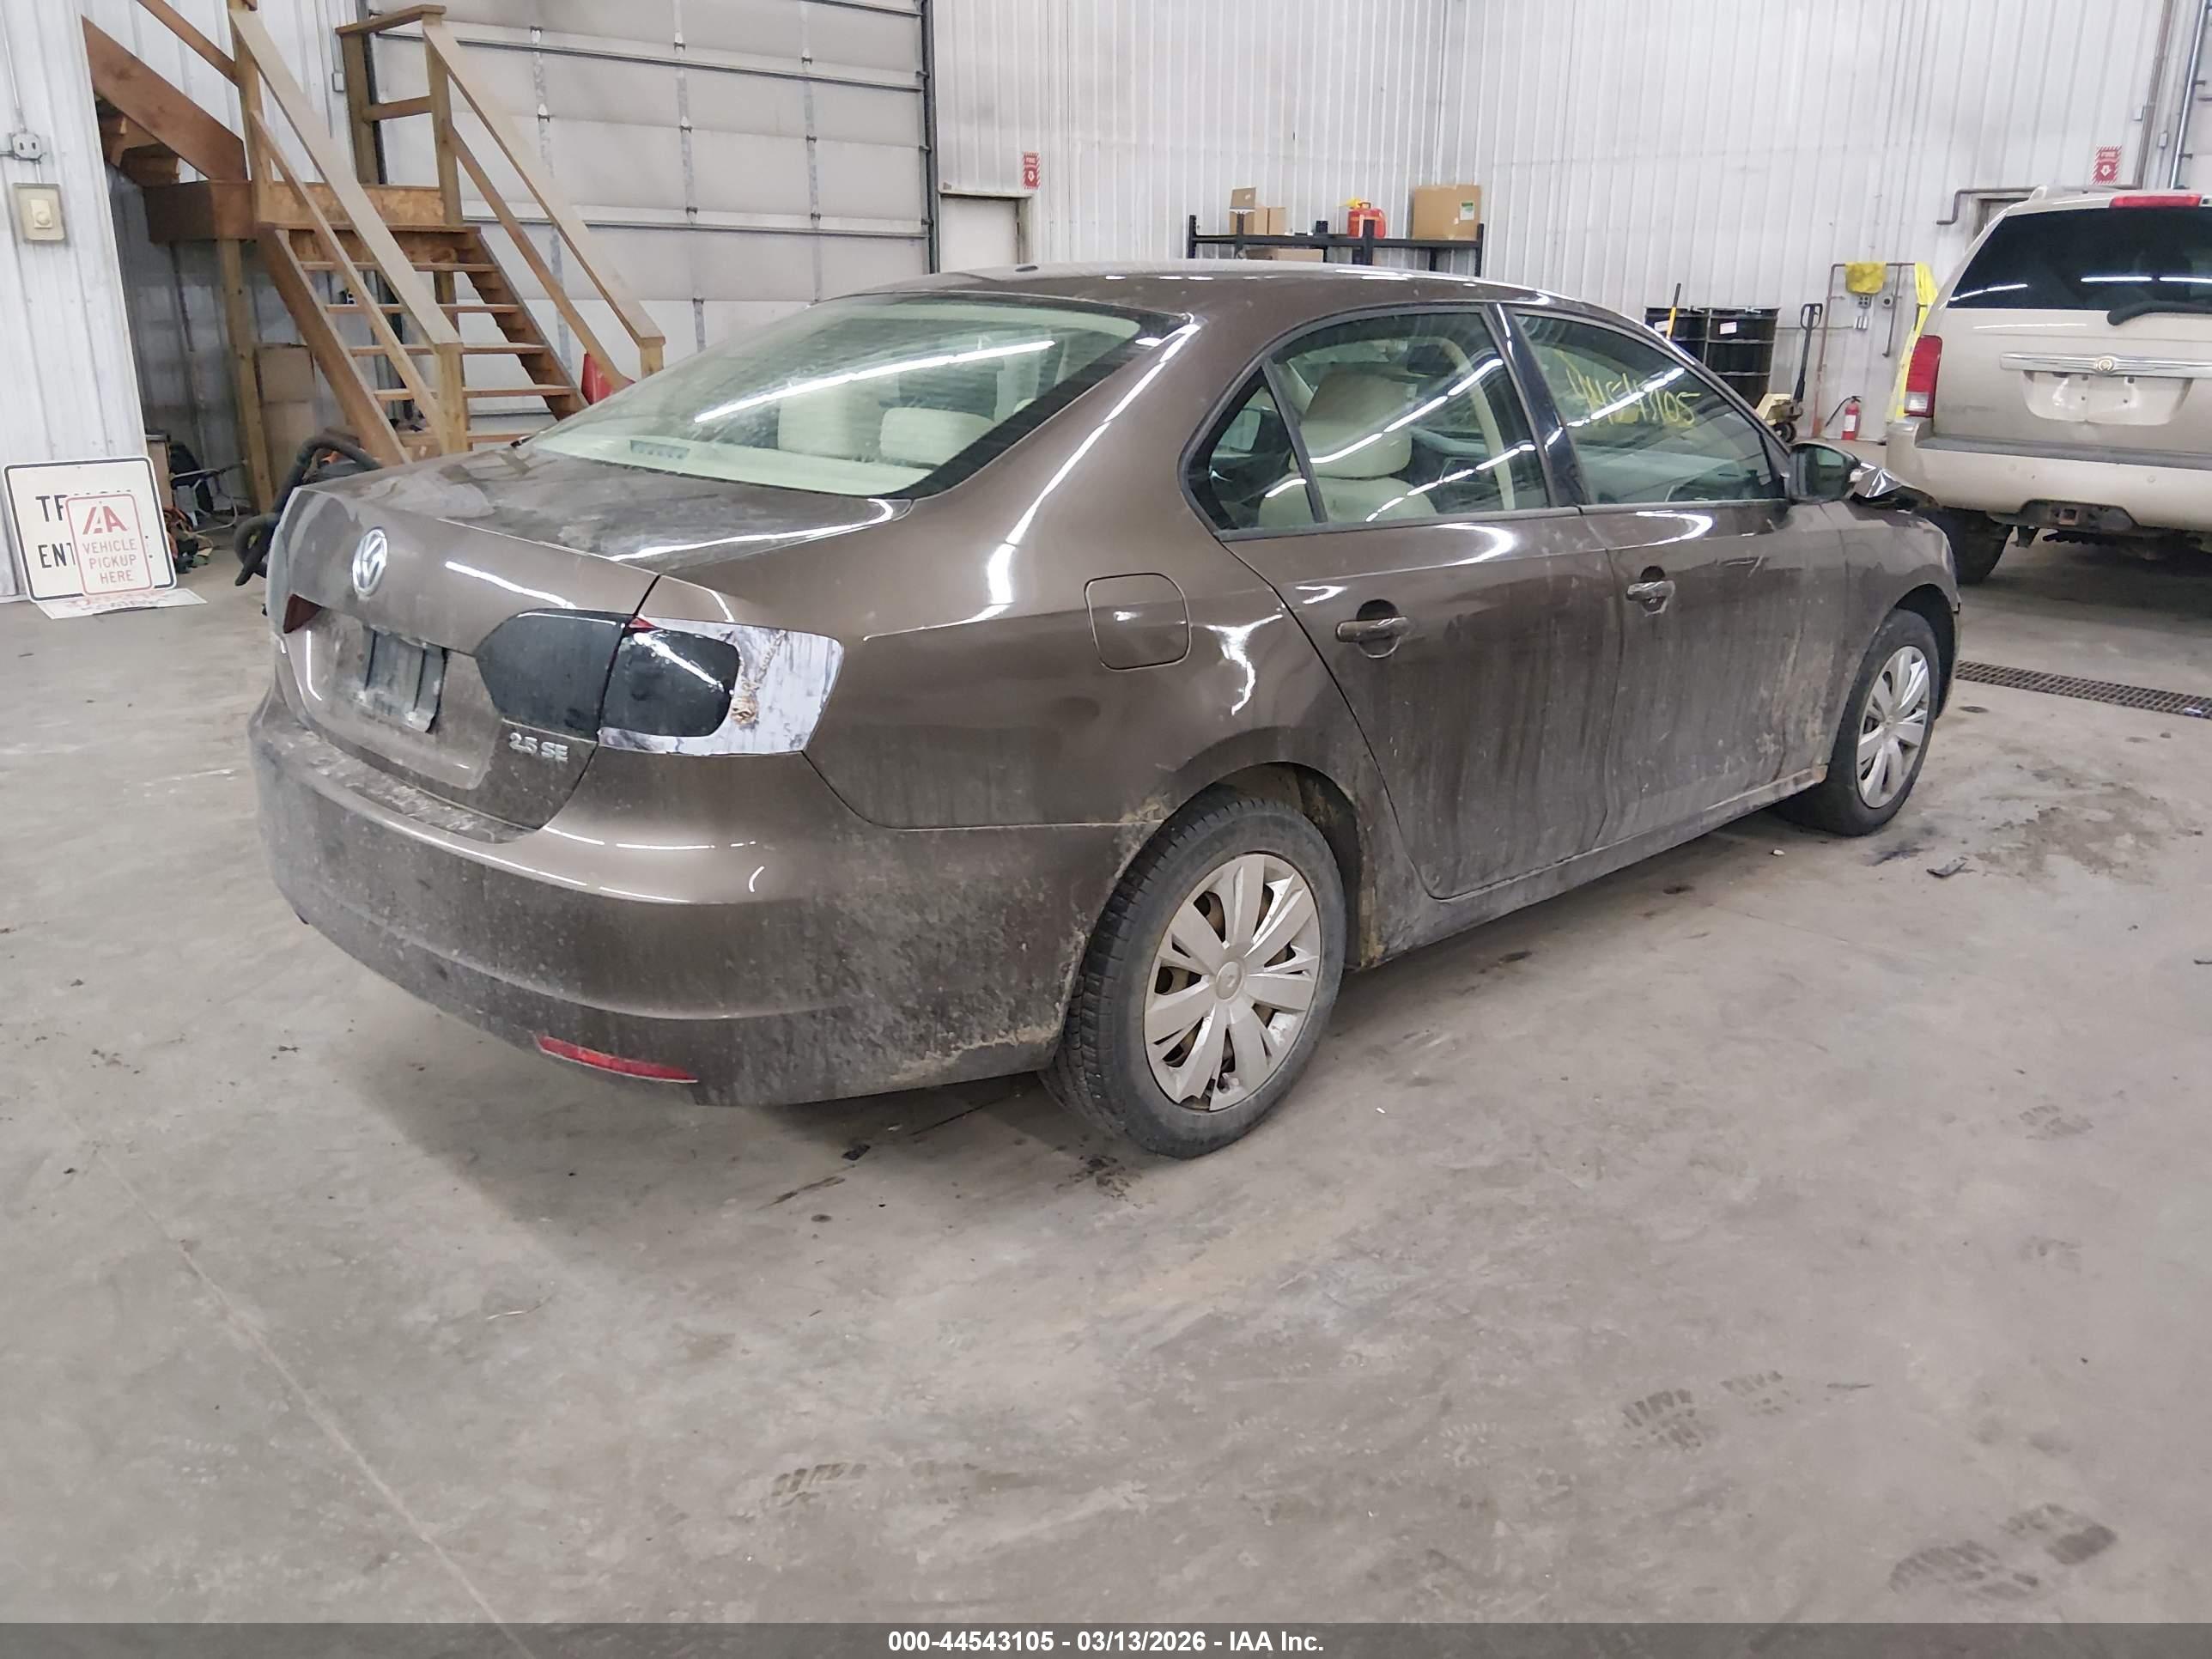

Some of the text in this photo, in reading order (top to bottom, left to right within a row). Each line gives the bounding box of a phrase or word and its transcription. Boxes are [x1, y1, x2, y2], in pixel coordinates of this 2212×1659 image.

[82, 538, 137, 554] VEHICLE
[88, 554, 137, 570] PICKUP
[99, 569, 135, 585] HERE
[541, 741, 568, 763] SE
